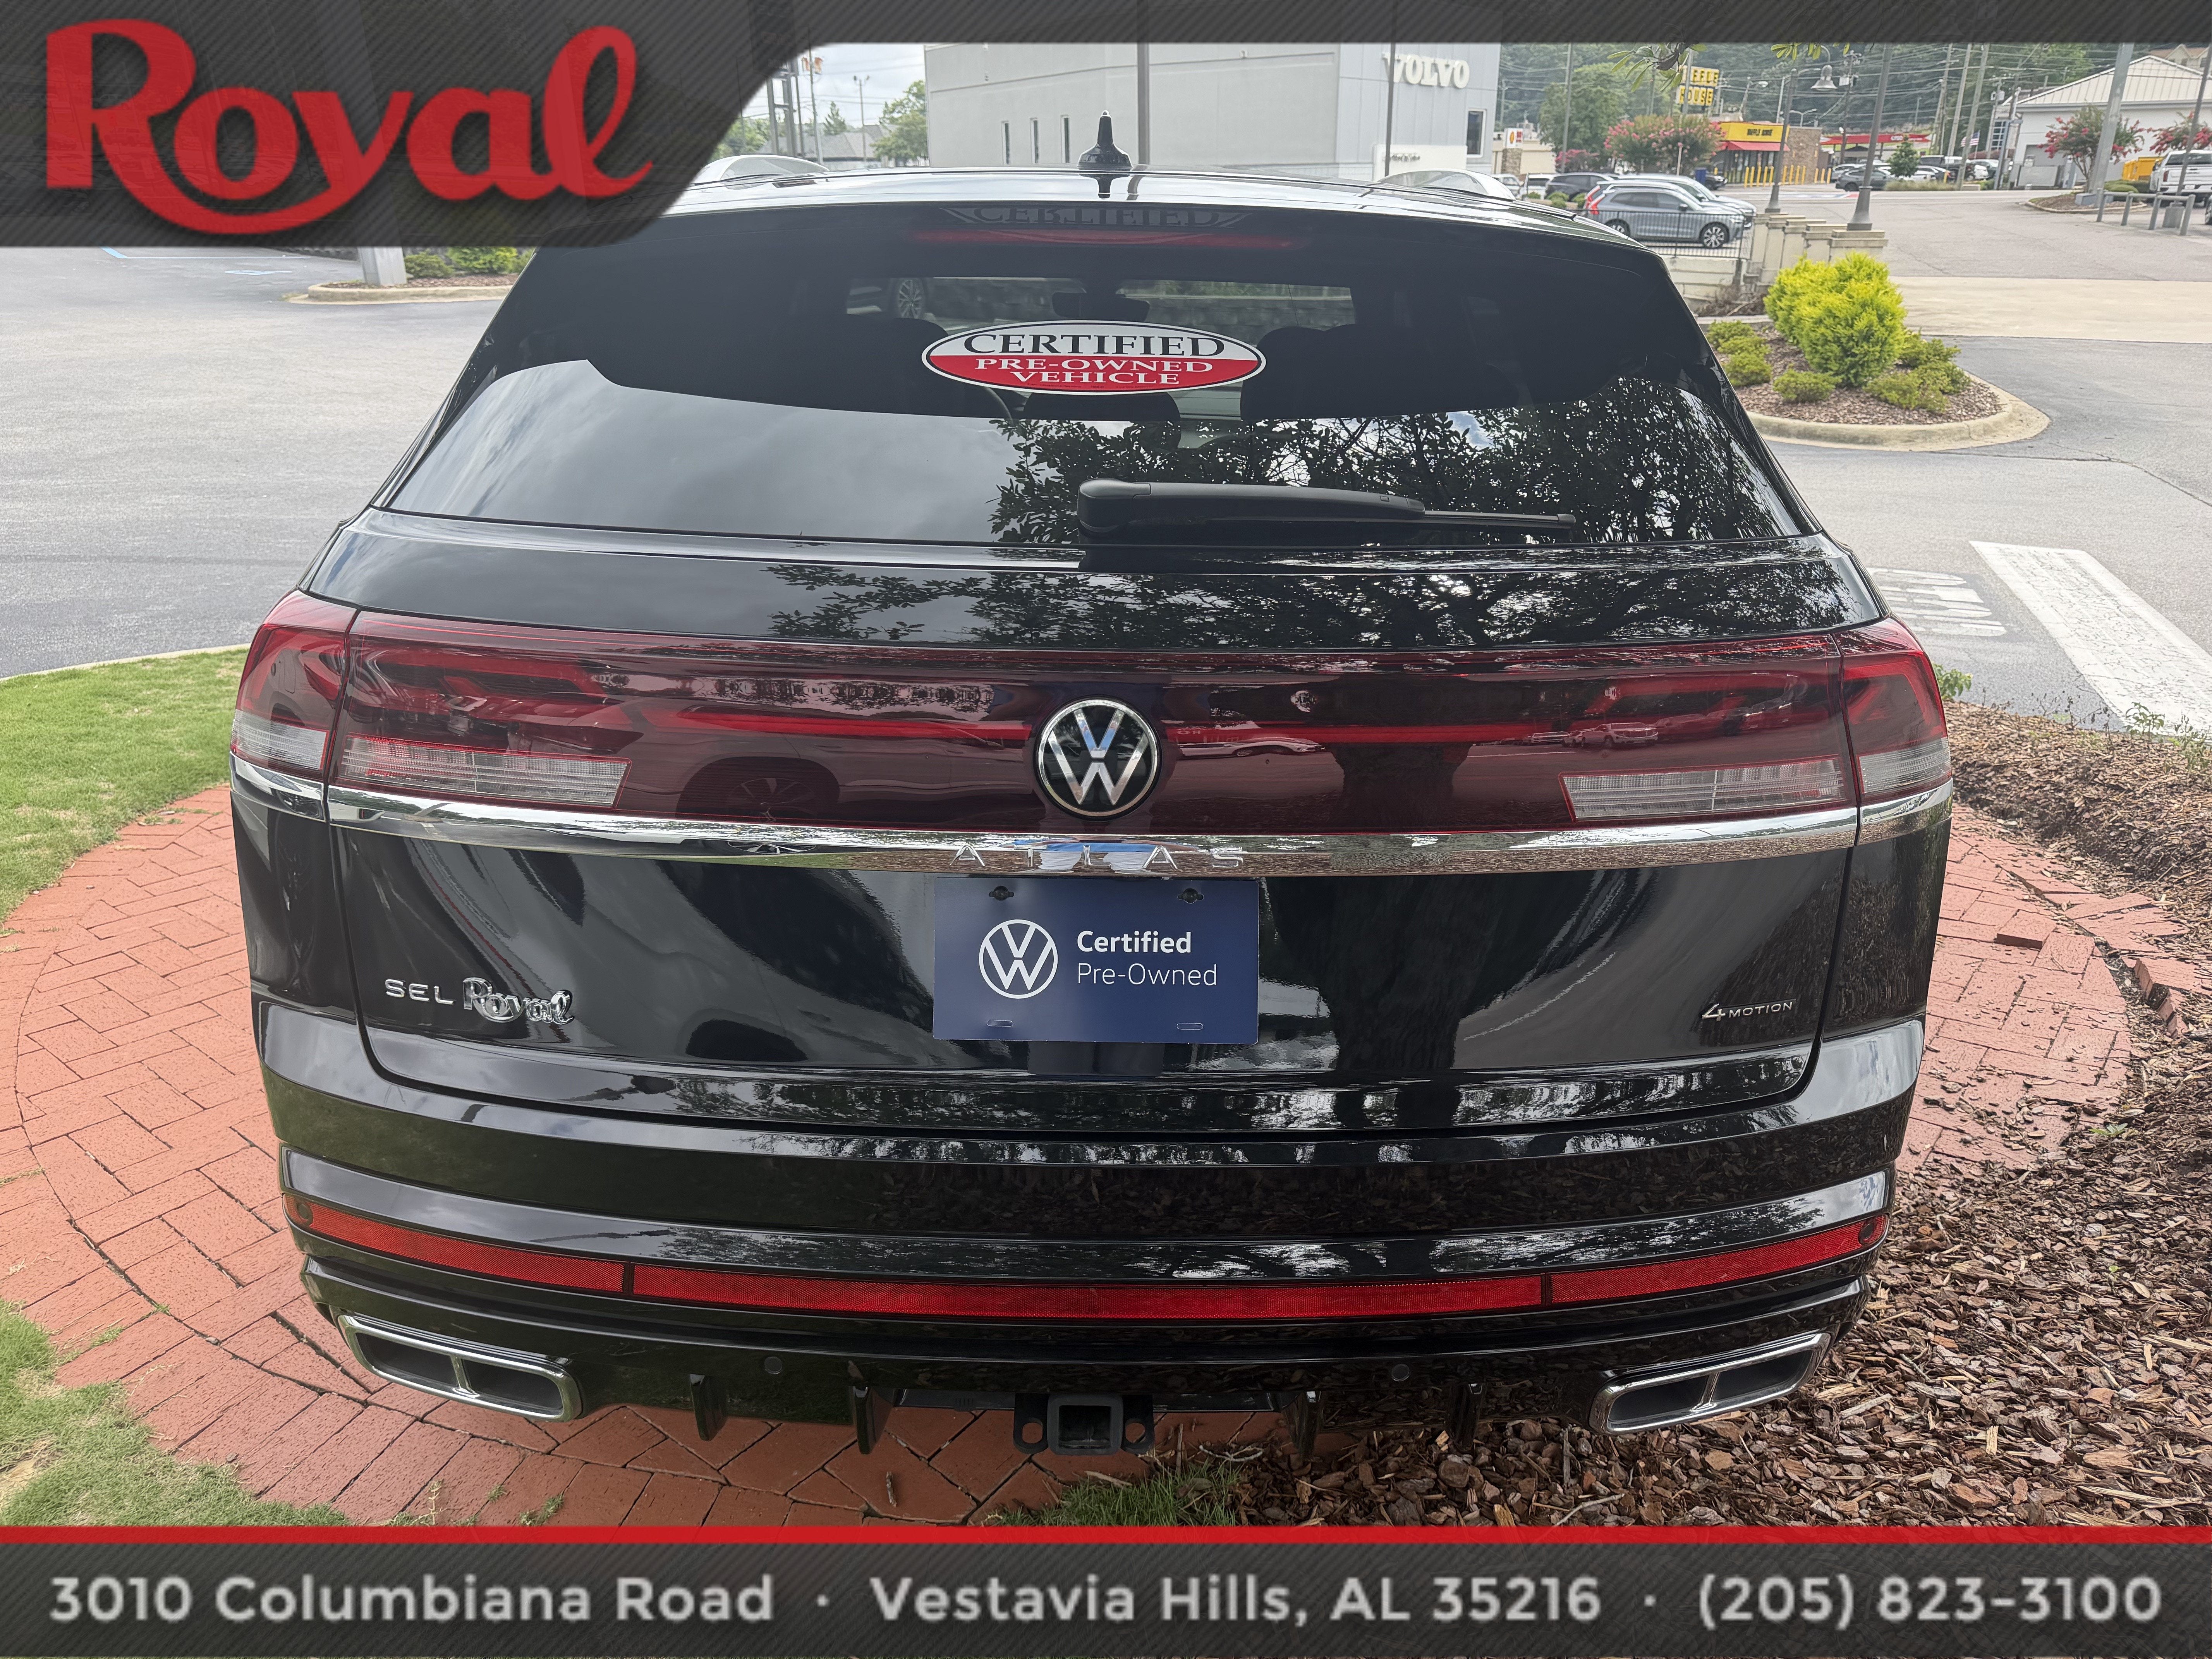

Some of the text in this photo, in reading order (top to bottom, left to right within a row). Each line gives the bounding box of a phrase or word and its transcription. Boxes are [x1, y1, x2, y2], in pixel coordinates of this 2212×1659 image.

[1382, 52, 1470, 89] VOLVO
[964, 334, 1224, 356] CERTIFIED
[975, 359, 1213, 373] PRE-OWNED
[1010, 371, 1180, 384] VEHICLE
[949, 845, 1244, 870] ATLAS
[1077, 930, 1192, 953] Certified
[1078, 962, 1217, 986] Pre-Owned
[385, 979, 456, 1005] SEL
[463, 977, 575, 1025] Royal
[1702, 1001, 1793, 1022] 4MOTION
